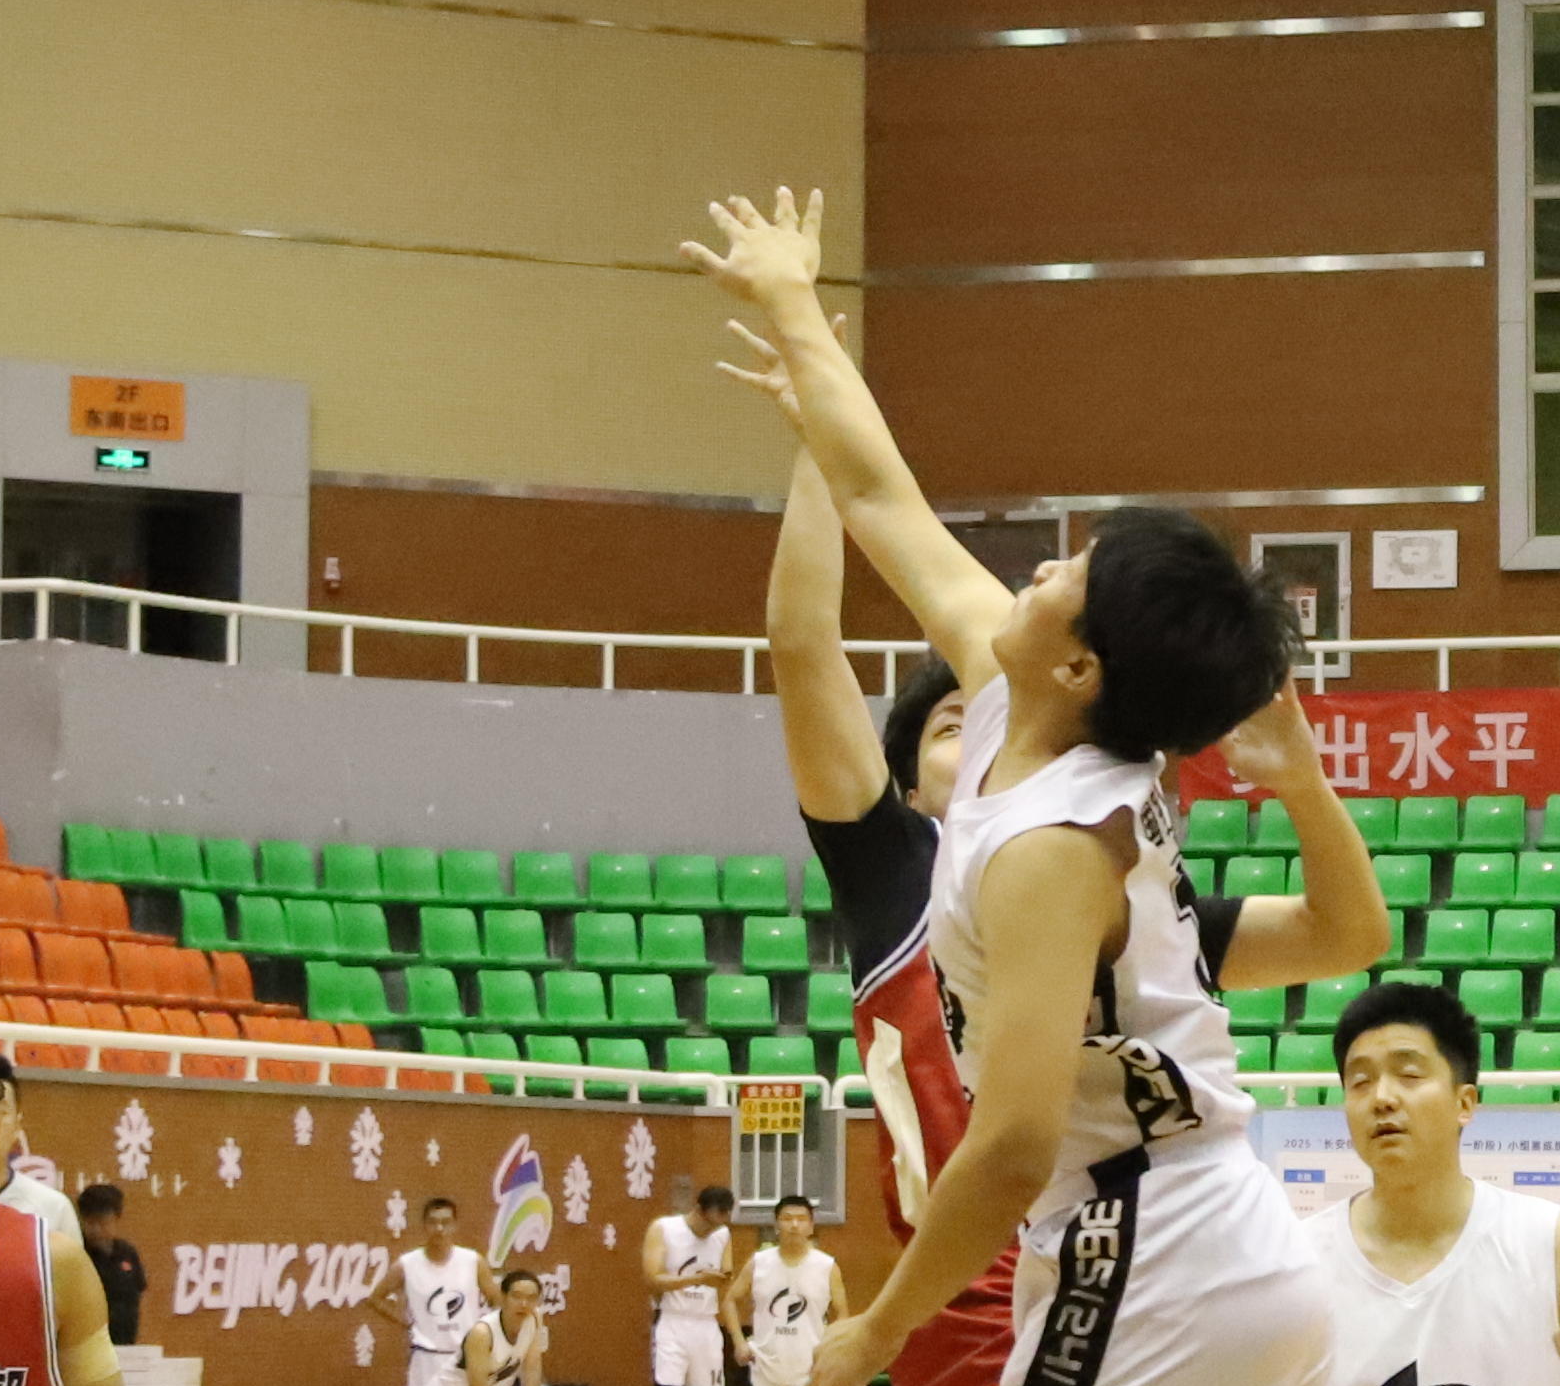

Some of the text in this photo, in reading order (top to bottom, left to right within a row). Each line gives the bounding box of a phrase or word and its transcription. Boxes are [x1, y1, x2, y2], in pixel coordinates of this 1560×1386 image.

[1228, 712, 1535, 793] 出水平
[172, 1242, 390, 1330] BEIJING 2022
[710, 1369, 723, 1386] 14
